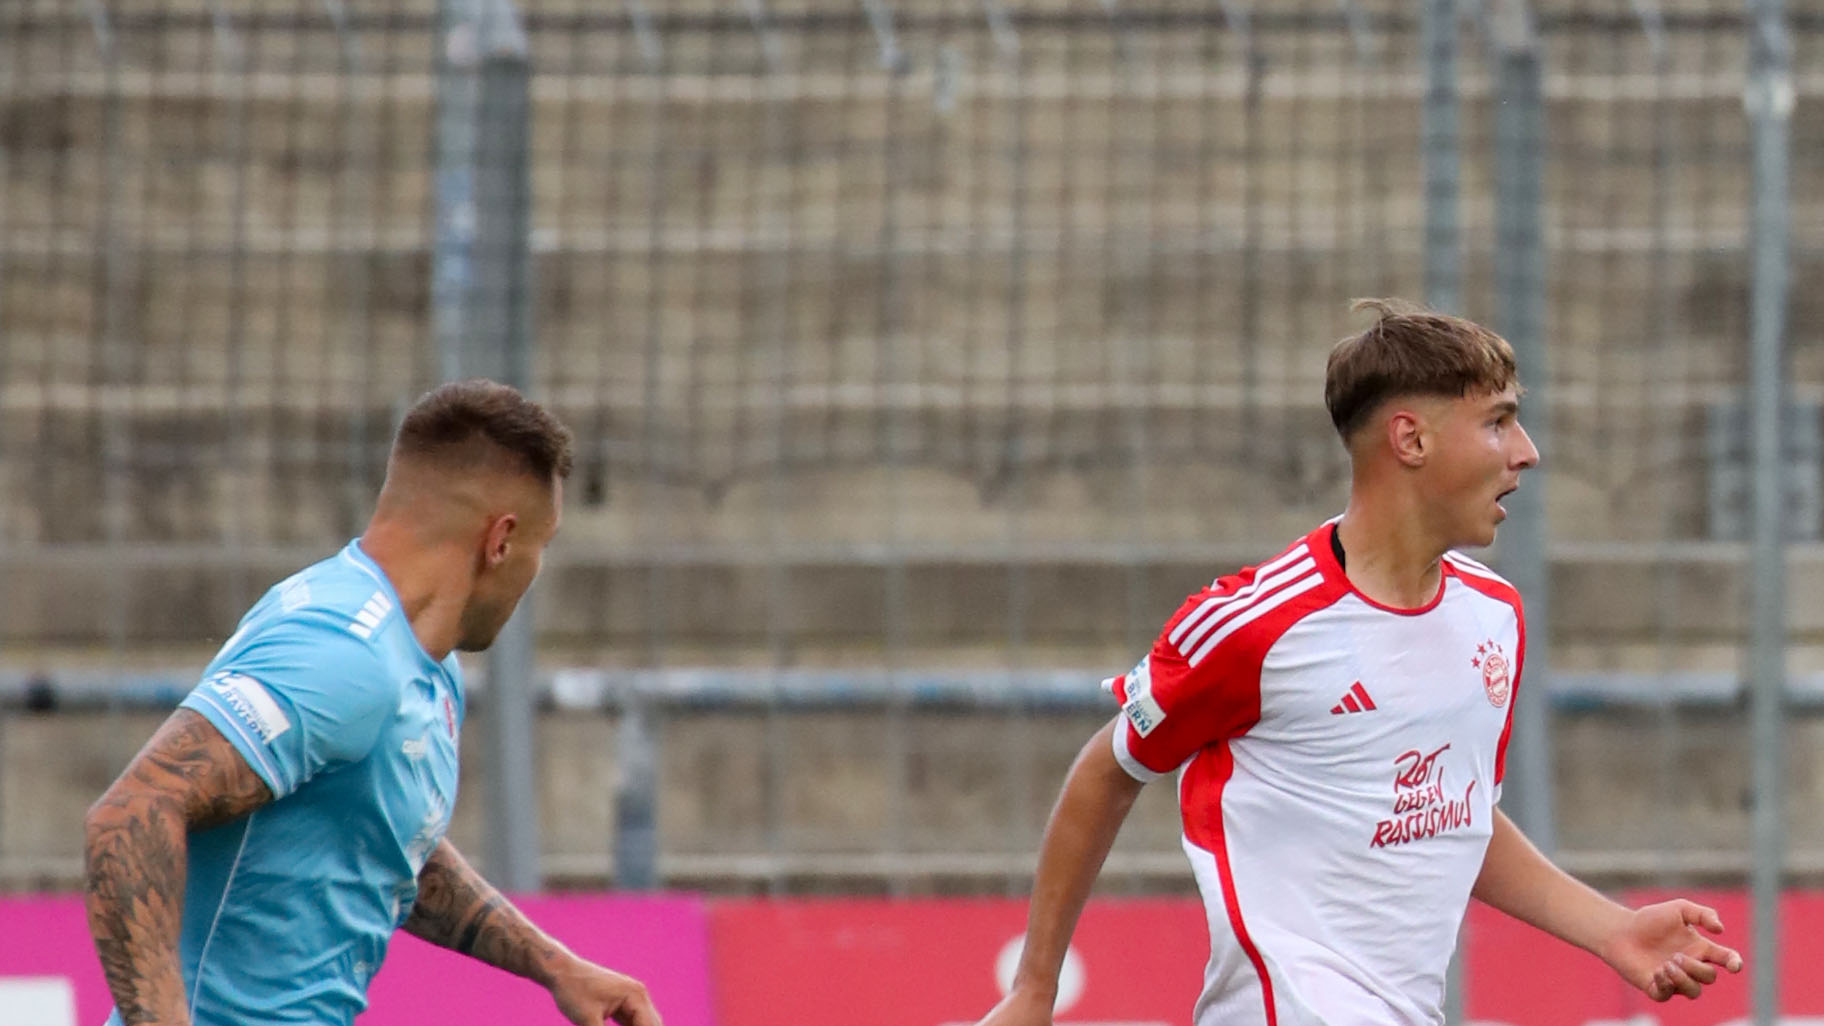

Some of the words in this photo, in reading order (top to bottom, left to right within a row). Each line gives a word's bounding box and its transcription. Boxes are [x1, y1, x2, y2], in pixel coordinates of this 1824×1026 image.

[1393, 765, 1444, 815] GEGEN
[1394, 743, 1451, 794] ROT
[1369, 779, 1476, 849] RASSISMUS
